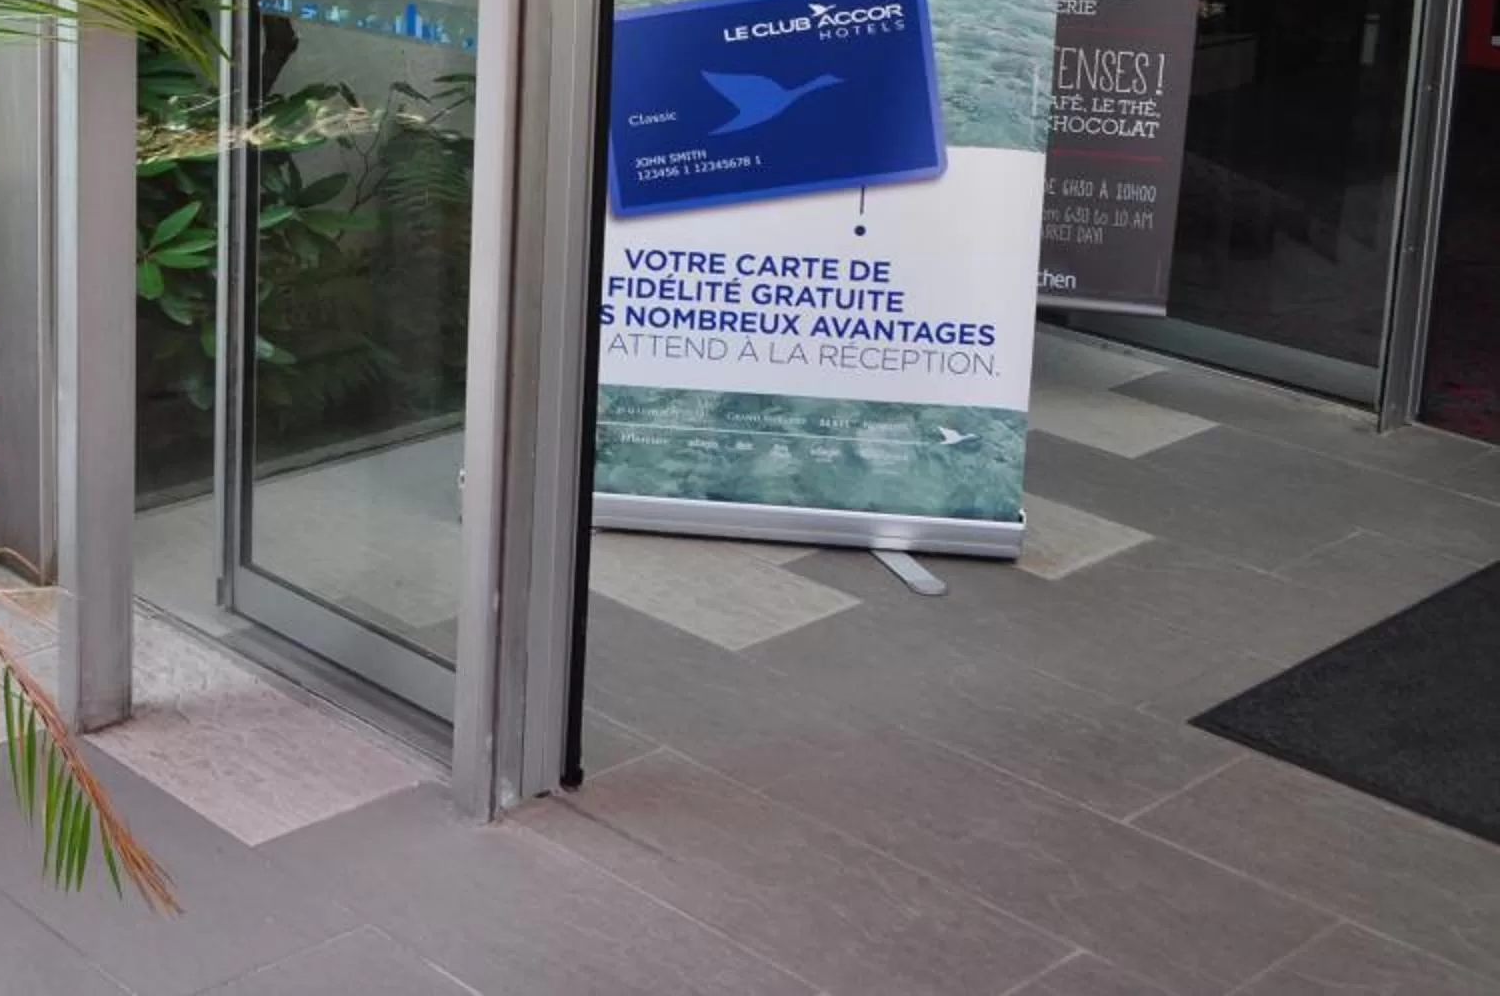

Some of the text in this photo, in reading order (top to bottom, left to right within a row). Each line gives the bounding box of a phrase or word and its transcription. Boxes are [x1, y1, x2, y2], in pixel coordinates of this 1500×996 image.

[724, 3, 904, 42] LE CLUB ACCOR
[819, 19, 906, 42] HOTELS
[628, 110, 677, 127] Classic
[1092, 97, 1115, 114] LE
[636, 149, 708, 169] JOHN SMITH
[638, 164, 681, 181] 123456
[695, 156, 751, 174] 12345678
[625, 248, 891, 284] VOTRE CARTE DE
[608, 273, 905, 314] FIDÉLITÉ GRATUITE
[626, 306, 801, 335] NOMBREUX
[810, 316, 996, 347] AVANTAGES
[607, 333, 1001, 377] ATTEND À LA RÉCEPTION.
